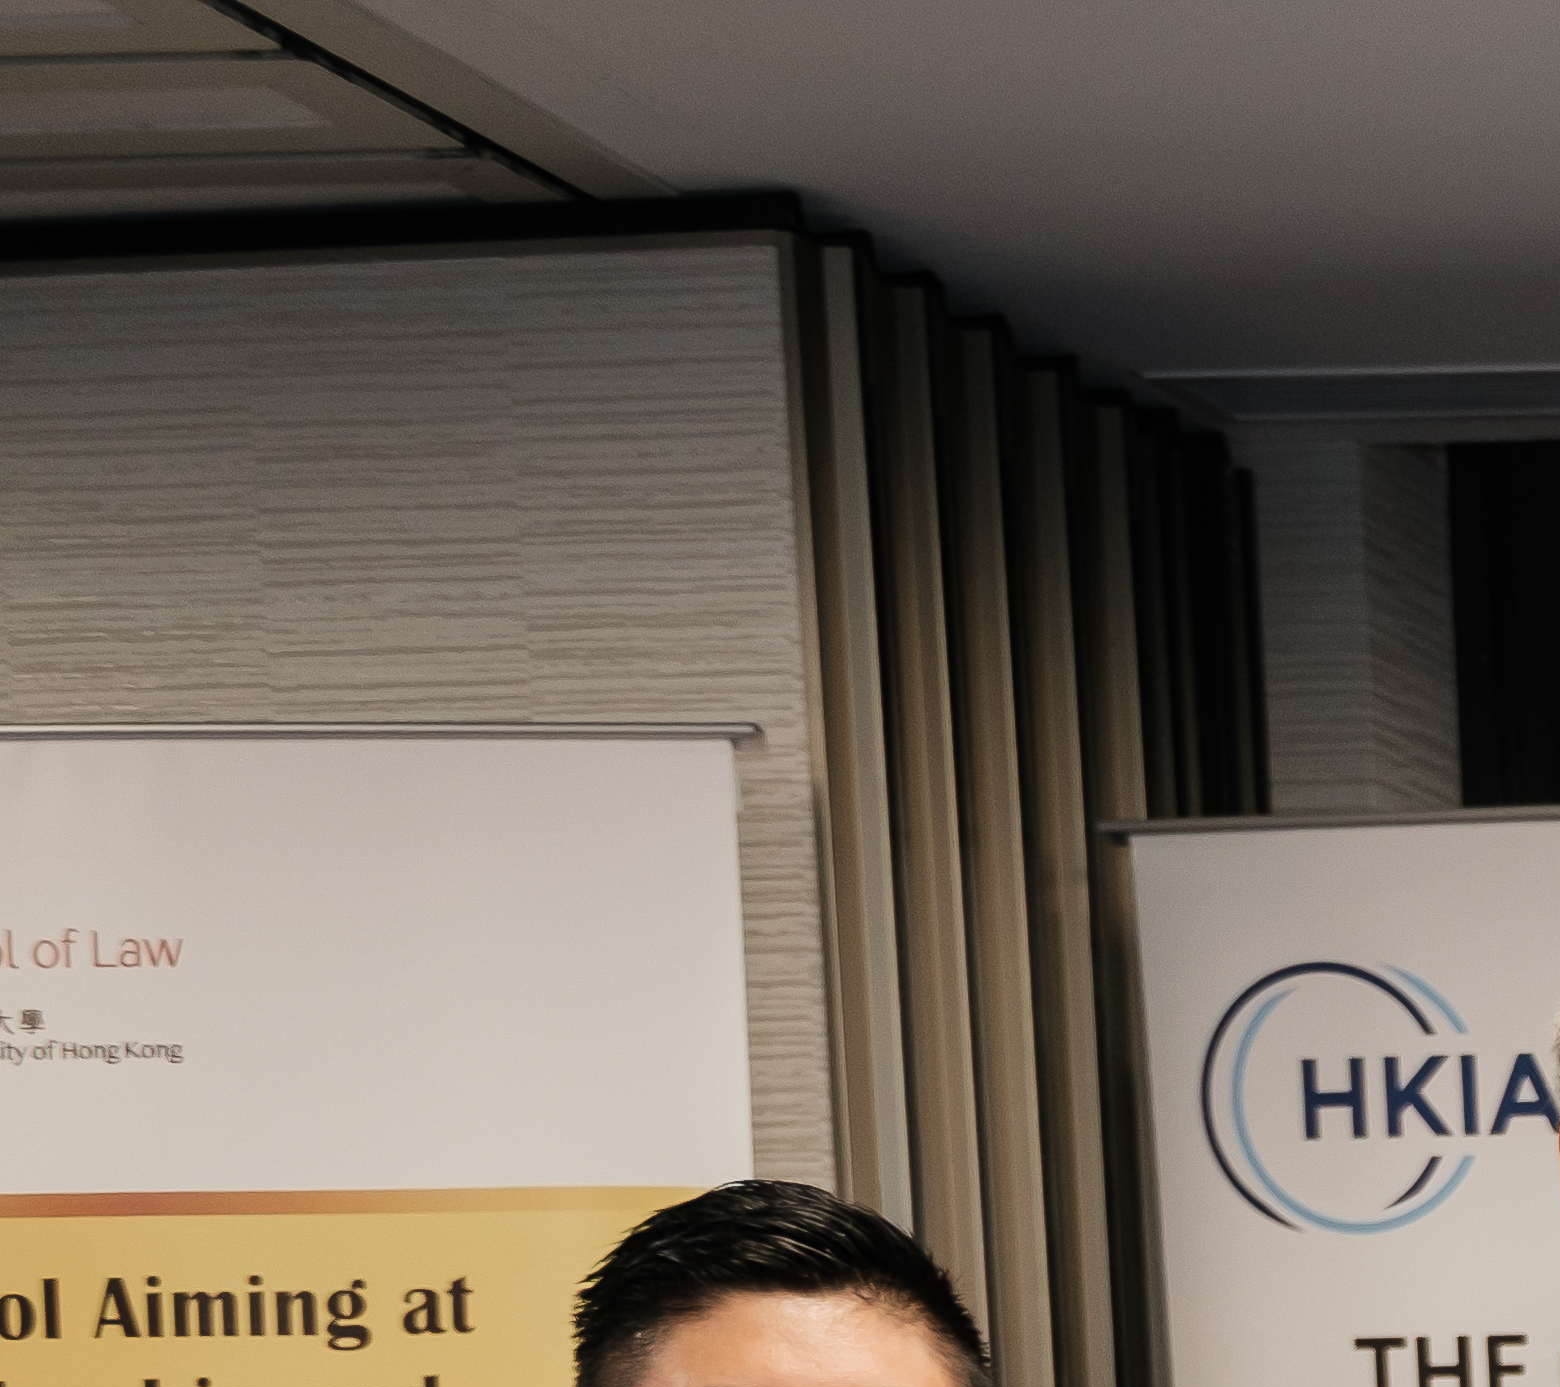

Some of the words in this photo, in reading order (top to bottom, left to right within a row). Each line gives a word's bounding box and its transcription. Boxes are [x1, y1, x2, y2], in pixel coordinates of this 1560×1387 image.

[31, 927, 80, 969] of
[90, 929, 184, 969] Law
[32, 1039, 58, 1060] of
[61, 1041, 121, 1064] Hong
[124, 1040, 185, 1064] Kong
[93, 1274, 374, 1352] Aiming
[401, 1275, 477, 1336] at
